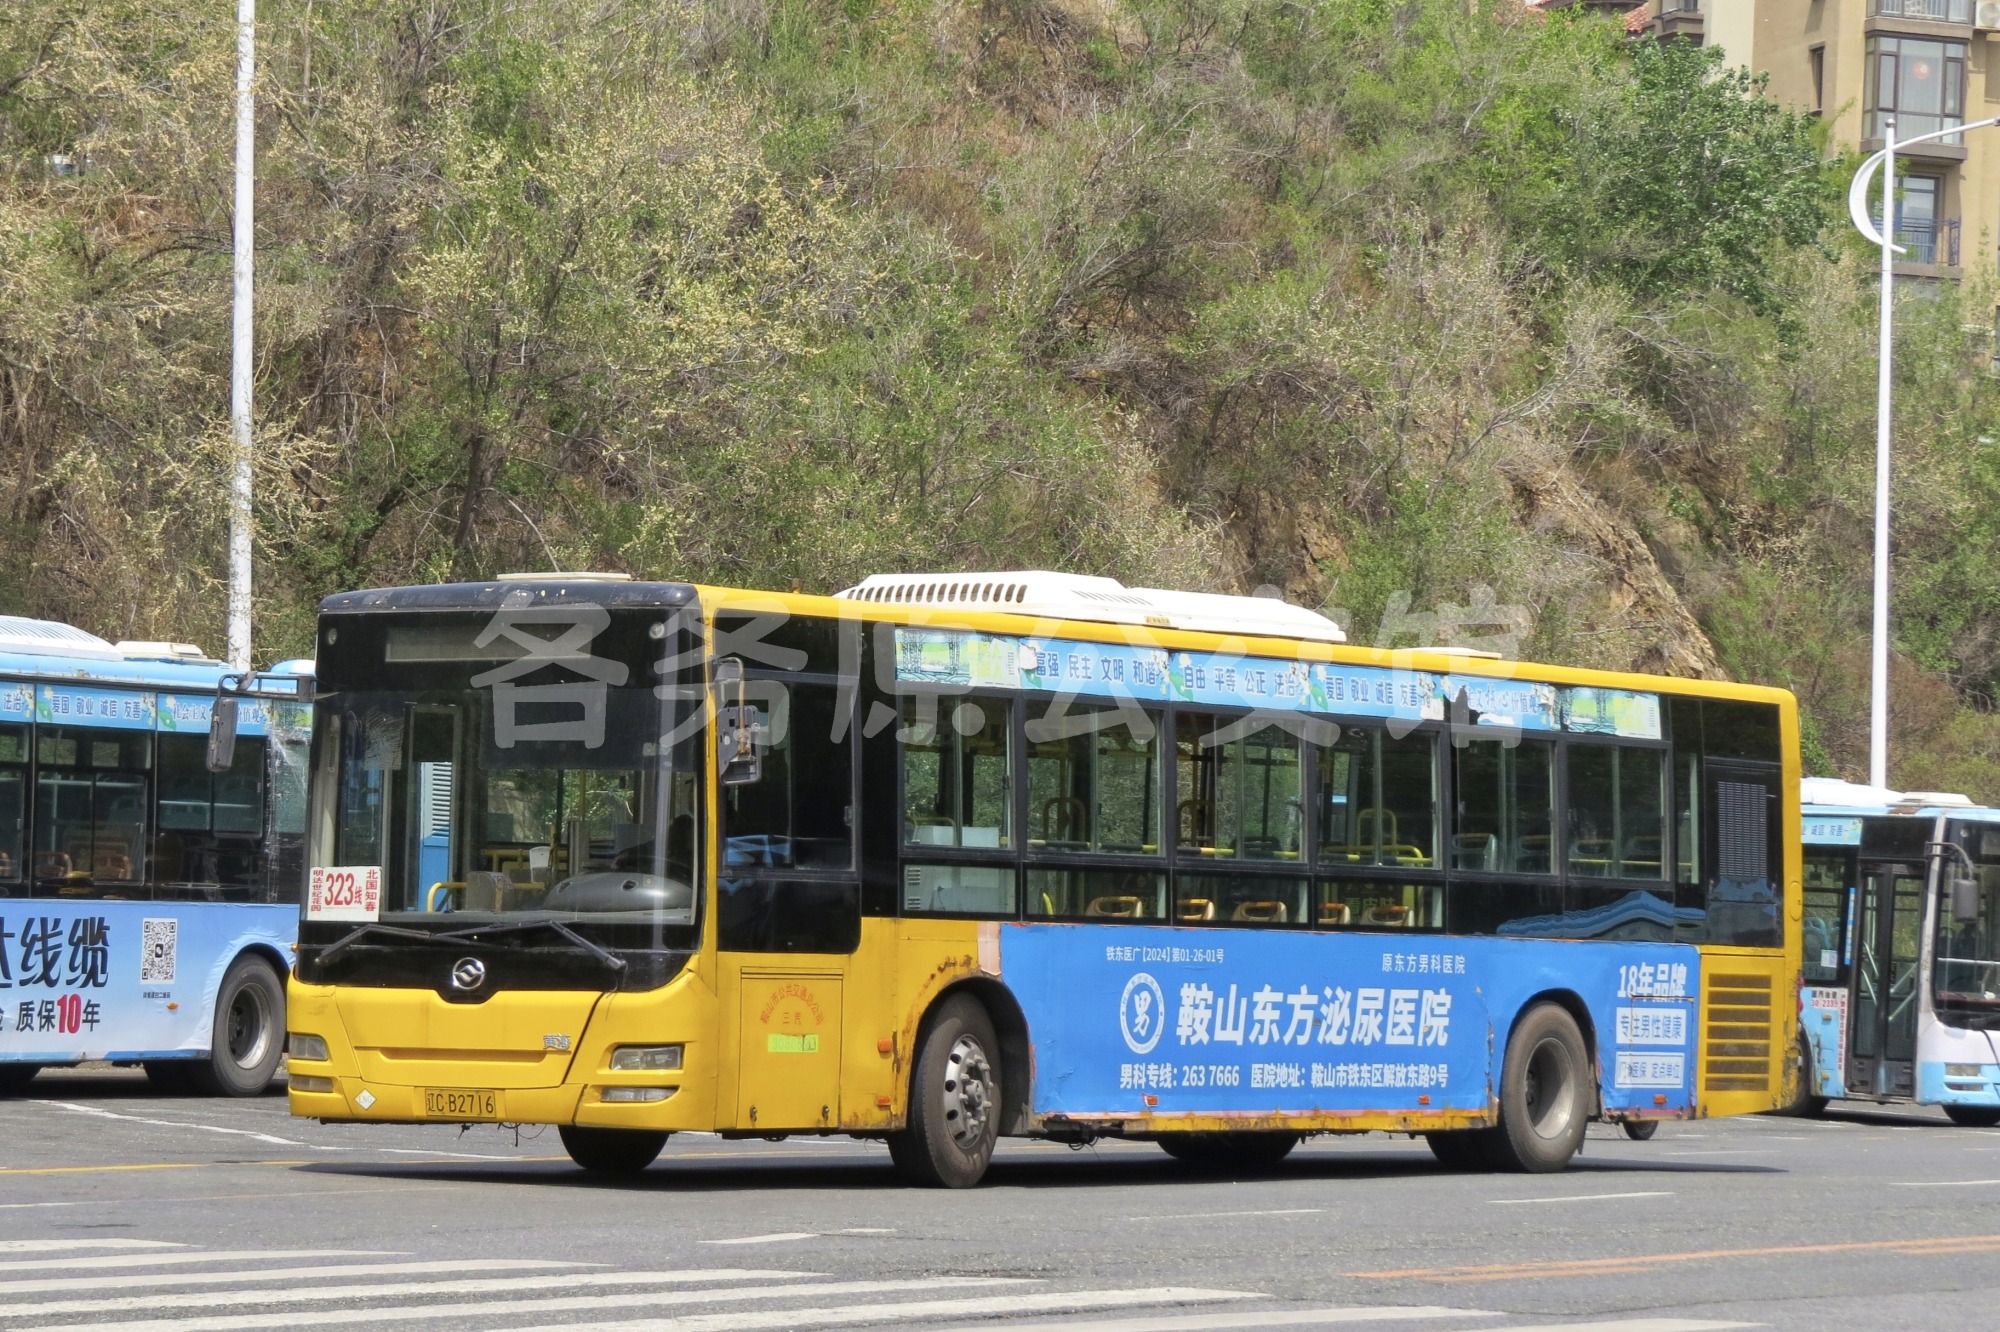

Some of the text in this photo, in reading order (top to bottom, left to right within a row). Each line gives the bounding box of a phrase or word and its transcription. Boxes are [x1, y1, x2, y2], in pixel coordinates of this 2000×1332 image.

[1036, 652, 1060, 677] 富强
[1068, 654, 1092, 679] 民主
[1101, 657, 1124, 682] 文明
[1133, 660, 1156, 685] 和谐
[1184, 665, 1295, 697] 自由 平等 公正 法治
[3, 692, 22, 711] 法治
[52, 696, 141, 719] 爱国 敬业 诚信 友善
[1326, 676, 1344, 700] 爱国
[1351, 679, 1369, 702] 敬业
[1376, 680, 1393, 705] 诚信
[1400, 683, 1418, 707] 友善
[364, 869, 378, 912] 北国知春
[1382, 953, 1466, 974] 原东方男科医院
[1617, 962, 1688, 1003] 18年品牌
[16, 993, 101, 1035] 质保10年
[1175, 982, 1453, 1047] 鞍山东方泌尿医院
